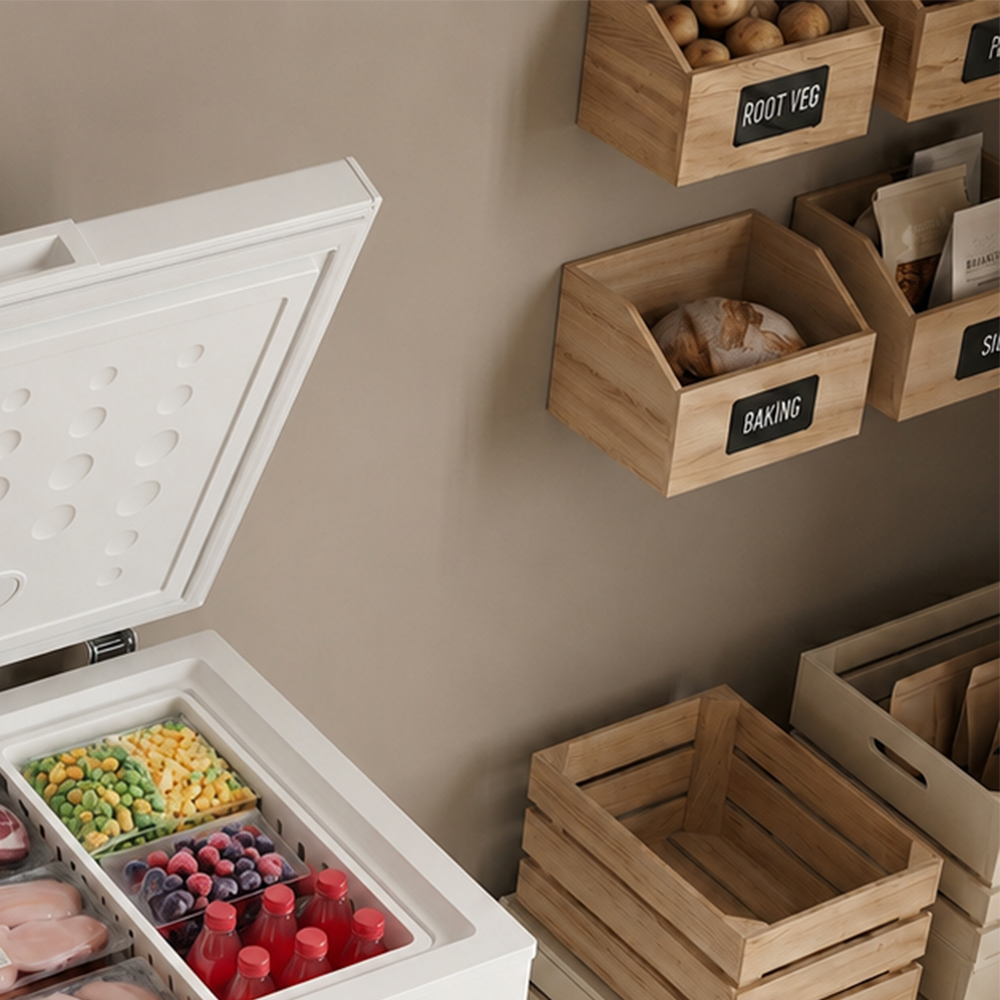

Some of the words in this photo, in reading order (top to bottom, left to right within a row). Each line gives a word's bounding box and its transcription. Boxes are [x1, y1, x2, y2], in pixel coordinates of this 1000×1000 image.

[742, 92, 788, 127] ROOT
[791, 84, 820, 113] VEG
[743, 395, 802, 435] BAKING
